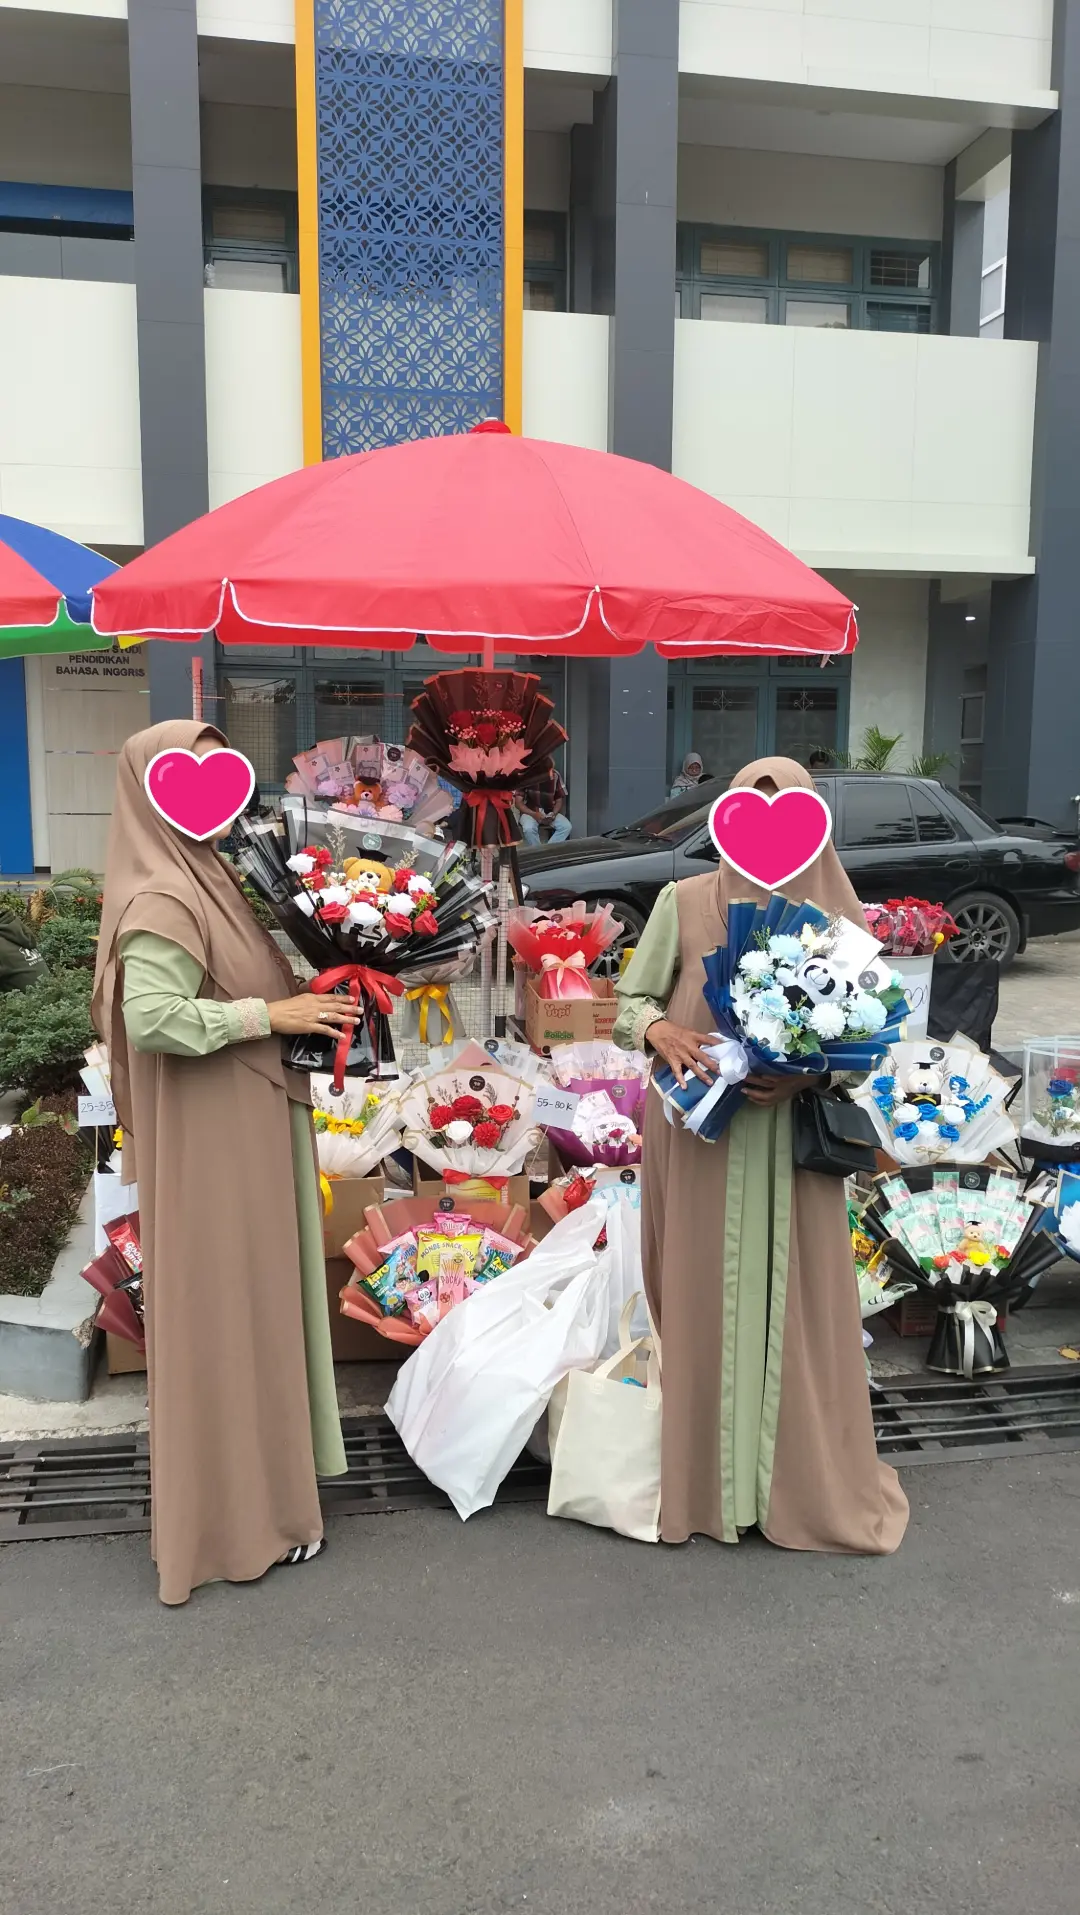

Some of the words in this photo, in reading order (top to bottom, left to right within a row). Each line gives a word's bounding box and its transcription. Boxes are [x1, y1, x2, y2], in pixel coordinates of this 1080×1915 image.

[69, 655, 130, 664] PENDIDIKAN
[56, 666, 99, 675] BAHASA
[103, 668, 146, 677] INGGRIS
